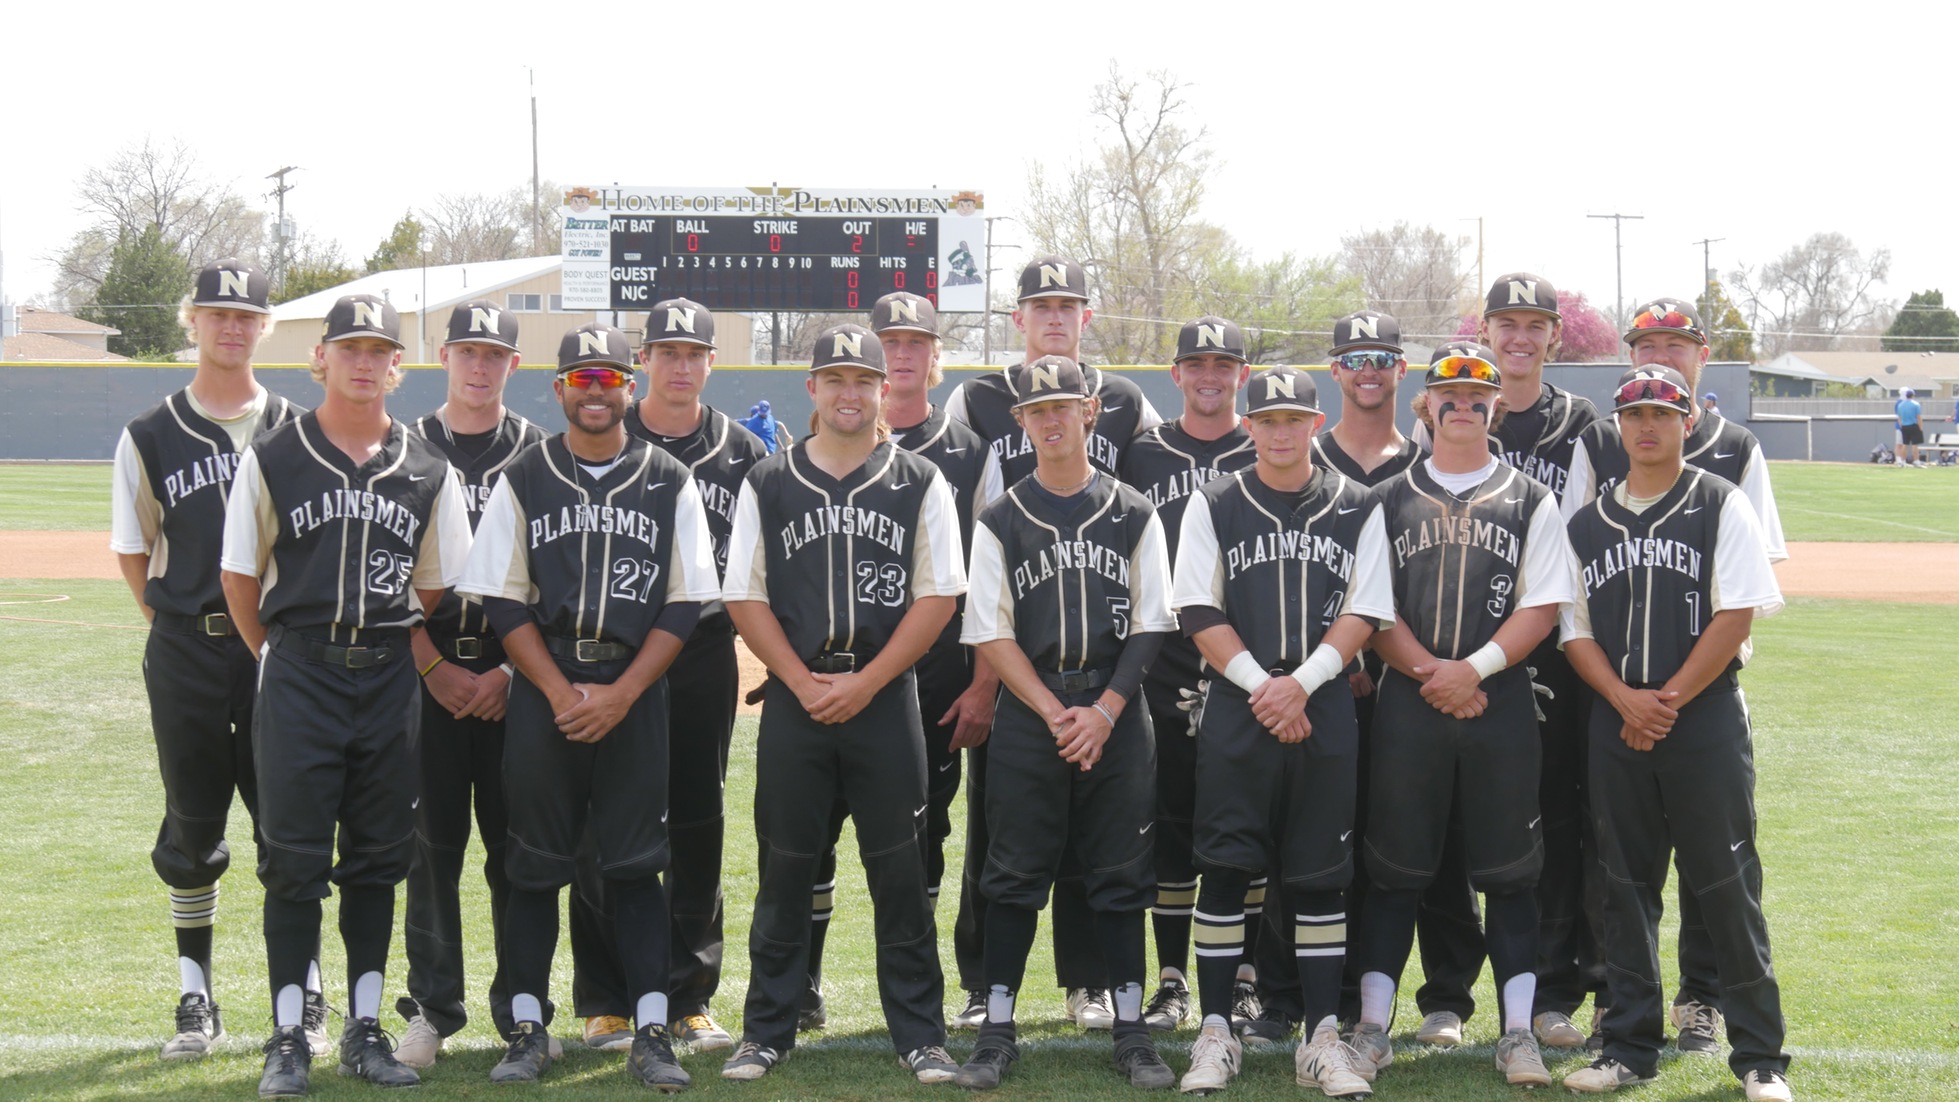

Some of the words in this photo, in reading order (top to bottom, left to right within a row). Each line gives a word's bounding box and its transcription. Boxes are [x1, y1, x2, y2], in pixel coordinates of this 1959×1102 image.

[600, 189, 685, 211] HOME
[693, 196, 725, 212] OF
[732, 195, 786, 213] THE
[794, 191, 949, 214] PLAINSMEN
[611, 219, 627, 233] AT
[630, 219, 655, 233] BAT
[676, 220, 709, 234] BALL
[753, 220, 798, 234] STRIKE
[843, 221, 872, 235] OUT
[905, 221, 926, 235] H/E
[688, 234, 698, 252] 0
[770, 235, 781, 253] 0
[852, 235, 863, 253] 2
[611, 267, 657, 281] GUEST
[663, 257, 667, 268] 1
[678, 257, 684, 268] 2
[694, 257, 700, 268] 3
[709, 257, 716, 268] 4
[725, 257, 732, 268] 5
[741, 257, 747, 268] 6
[756, 257, 763, 268] 7
[772, 257, 779, 268] 8
[788, 257, 795, 268] 9
[801, 257, 812, 268] 10
[831, 257, 860, 268] RUNS
[928, 257, 935, 268] E
[218, 270, 249, 299] N
[847, 271, 858, 288] 0
[894, 271, 905, 288] 0
[926, 271, 937, 288] 0
[1039, 263, 1069, 288] N
[621, 285, 648, 301] NJC
[847, 291, 858, 308] 0
[1508, 280, 1538, 305] N
[353, 302, 383, 330] N
[469, 307, 500, 335] N
[665, 307, 696, 334] N
[890, 299, 919, 323] N
[1196, 323, 1226, 349] N
[1349, 316, 1379, 340] N
[577, 329, 610, 356] N
[832, 332, 863, 359] N
[1031, 364, 1062, 393] N
[1266, 374, 1296, 399] N
[290, 489, 420, 548] PLAINSMEN
[530, 503, 659, 554] PLAINSMEN
[781, 505, 905, 560] PLAINSMEN
[1394, 516, 1520, 569] PLAINSMEN
[1227, 529, 1355, 583] PLAINSMEN
[1582, 537, 1702, 600] PLAINSMEN
[368, 549, 414, 595] 25
[611, 557, 660, 604] 27
[856, 560, 907, 608] 23
[1487, 574, 1513, 618] 3
[1106, 596, 1130, 640] 5
[1685, 590, 1700, 636] 1
